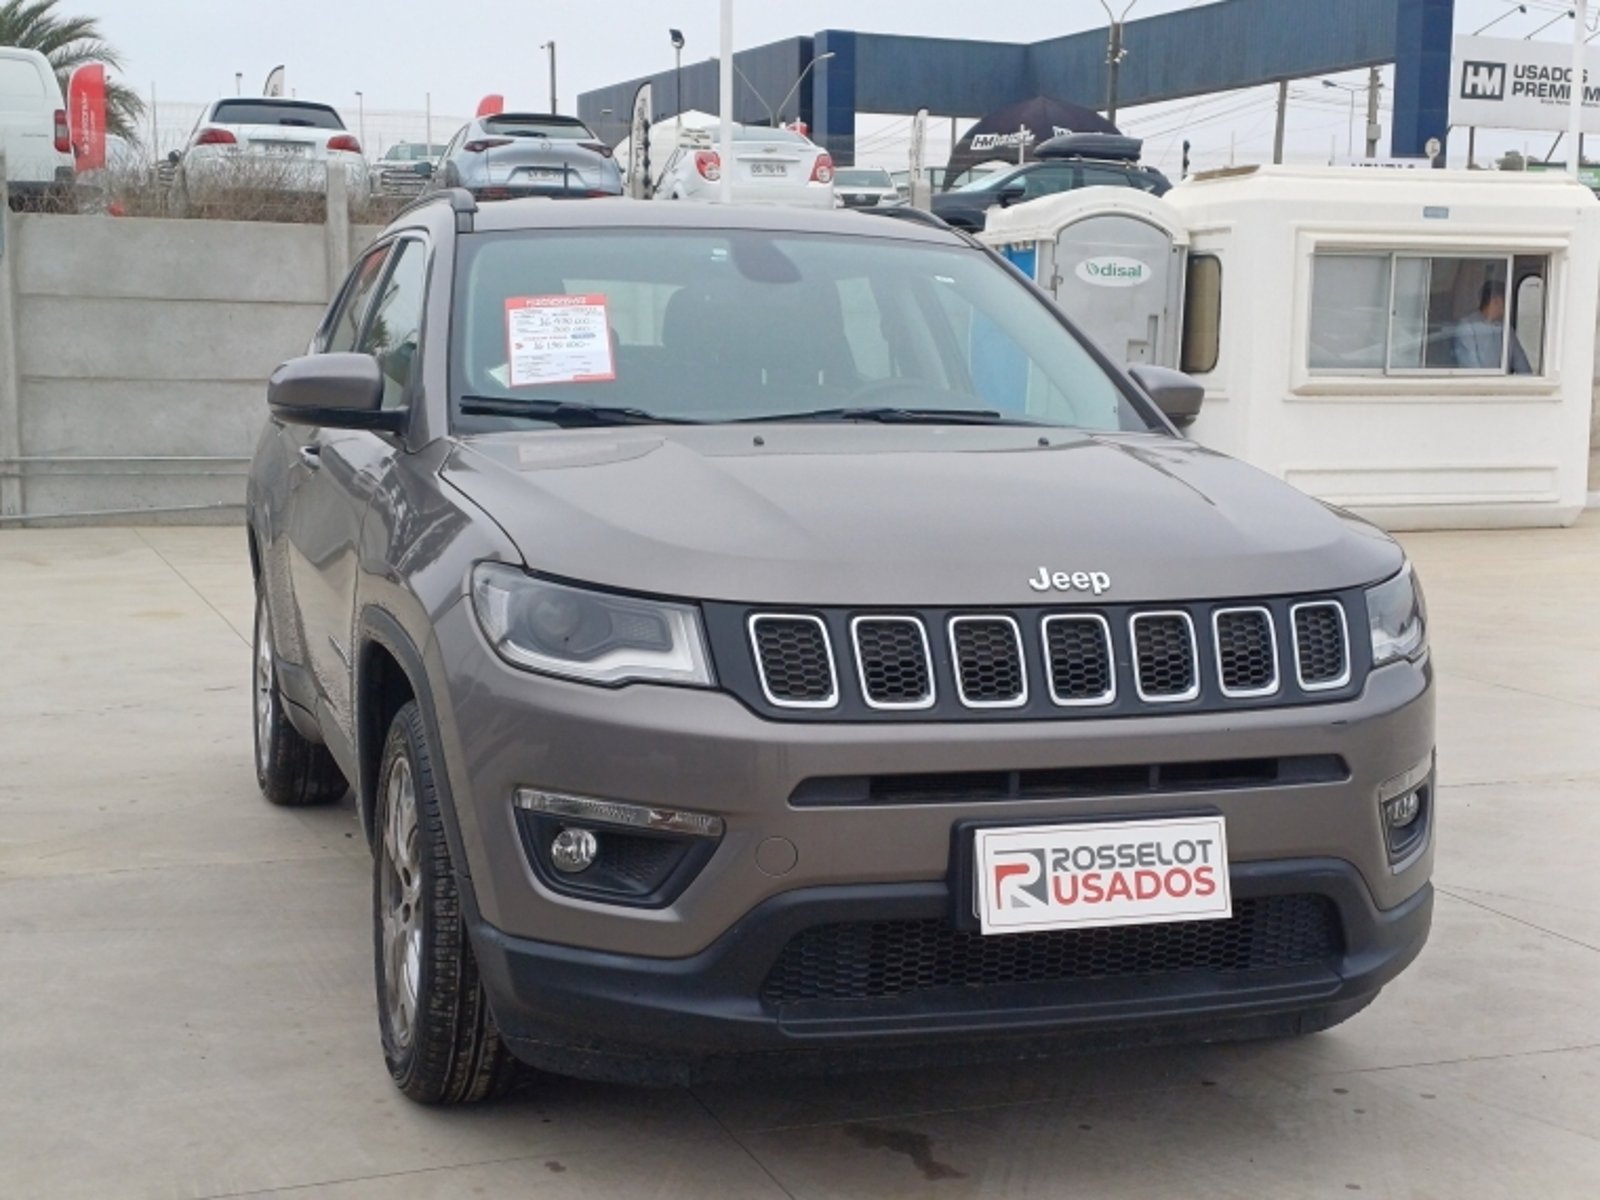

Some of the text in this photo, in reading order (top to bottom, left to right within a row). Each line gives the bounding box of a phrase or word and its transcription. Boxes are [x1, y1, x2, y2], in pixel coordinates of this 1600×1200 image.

[1463, 63, 1504, 98] HM
[1511, 81, 1600, 102] PREMIM
[1100, 262, 1142, 277] disal
[1028, 566, 1110, 595] Jeep
[1052, 839, 1213, 872] ROSSELOT
[1053, 866, 1216, 906] USADOS
